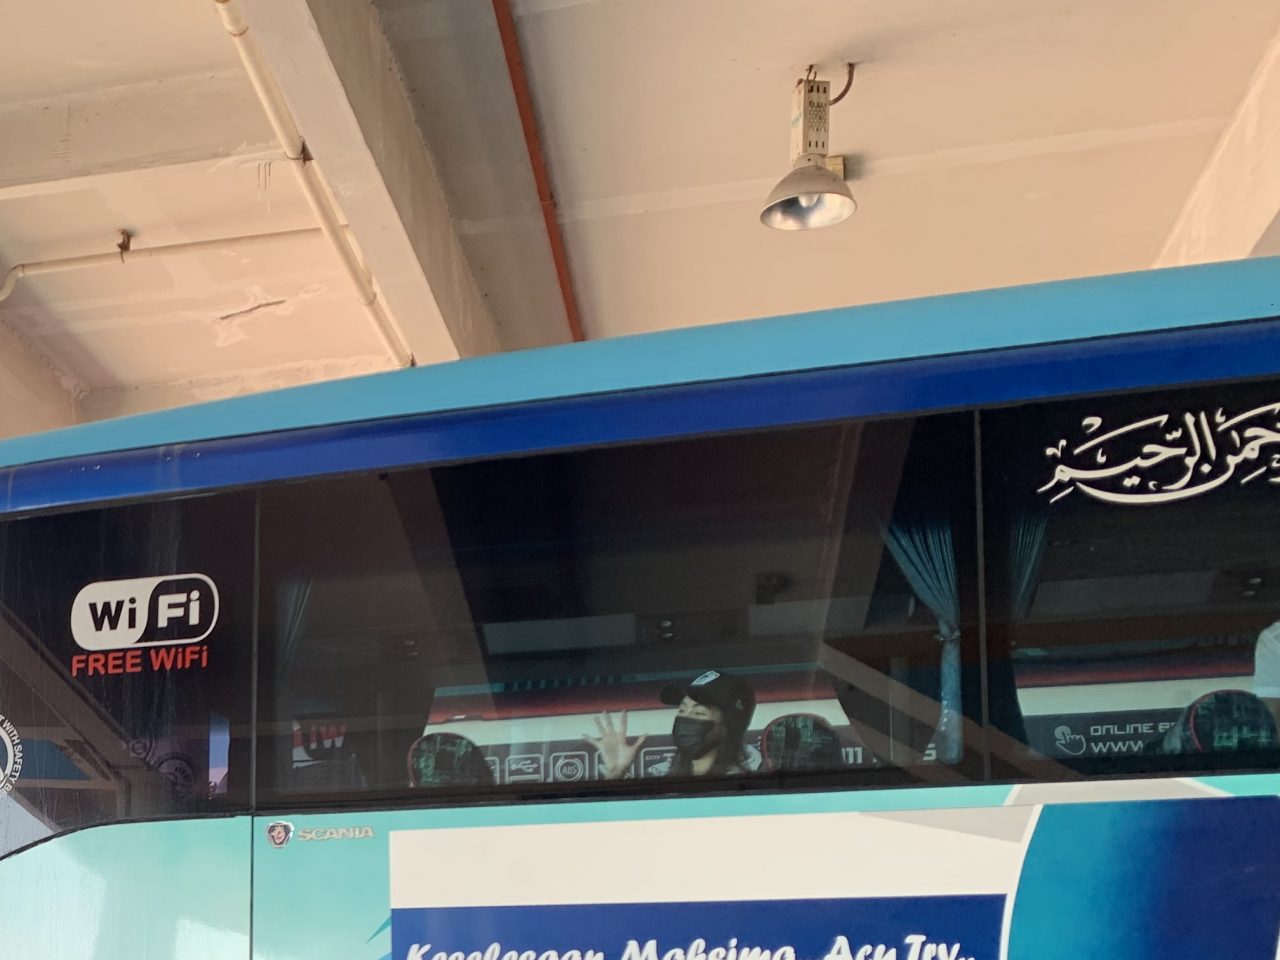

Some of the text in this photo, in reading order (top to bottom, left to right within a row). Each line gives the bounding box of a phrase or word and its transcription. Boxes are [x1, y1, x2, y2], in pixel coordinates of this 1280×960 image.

[71, 645, 209, 677] FREE WiFi
[2, 720, 20, 745] WITH
[9, 744, 23, 785] SAFETY
[297, 826, 375, 841] SCANIA
